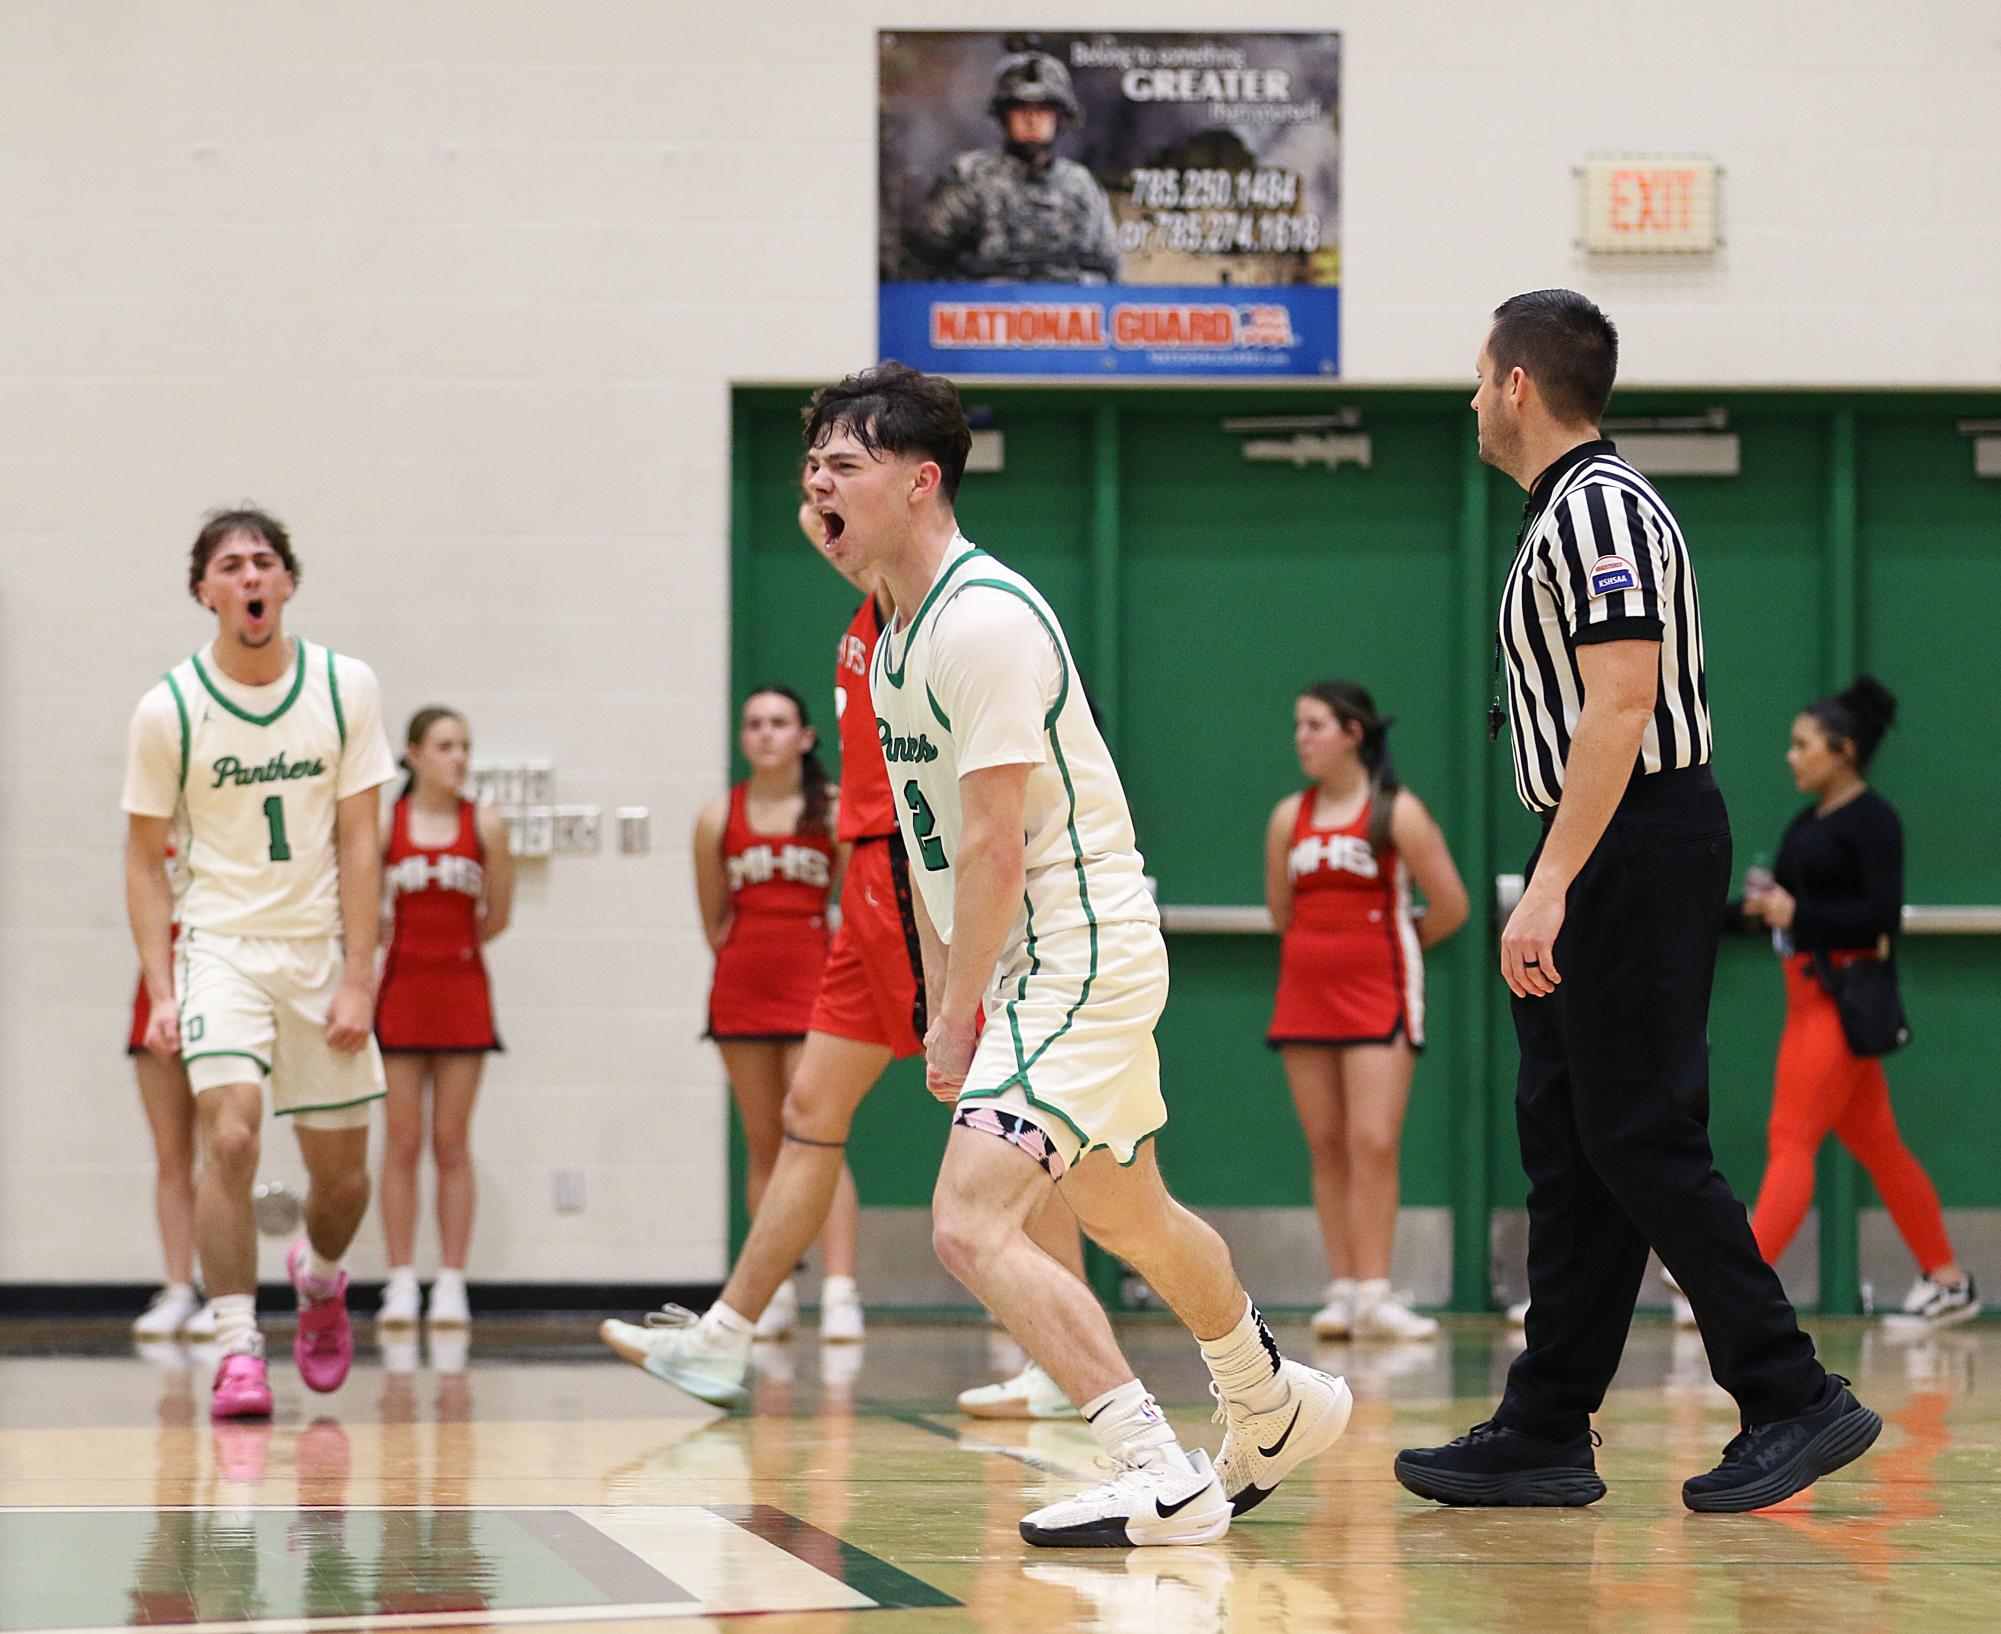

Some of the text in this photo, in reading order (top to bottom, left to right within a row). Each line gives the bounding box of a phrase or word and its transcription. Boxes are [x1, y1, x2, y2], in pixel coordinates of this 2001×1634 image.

[1121, 67, 1290, 102] GREATER
[1610, 168, 1697, 234] EXIT
[1118, 220, 1150, 251] or
[934, 306, 1237, 347] NATIONAL GUARD
[1598, 575, 1627, 587] KSHSAA
[211, 750, 326, 788] Panthers
[263, 795, 291, 861] 1
[904, 779, 950, 871] 2
[386, 853, 483, 895] MHS
[728, 844, 830, 890] MHS
[1289, 834, 1379, 880] MHS
